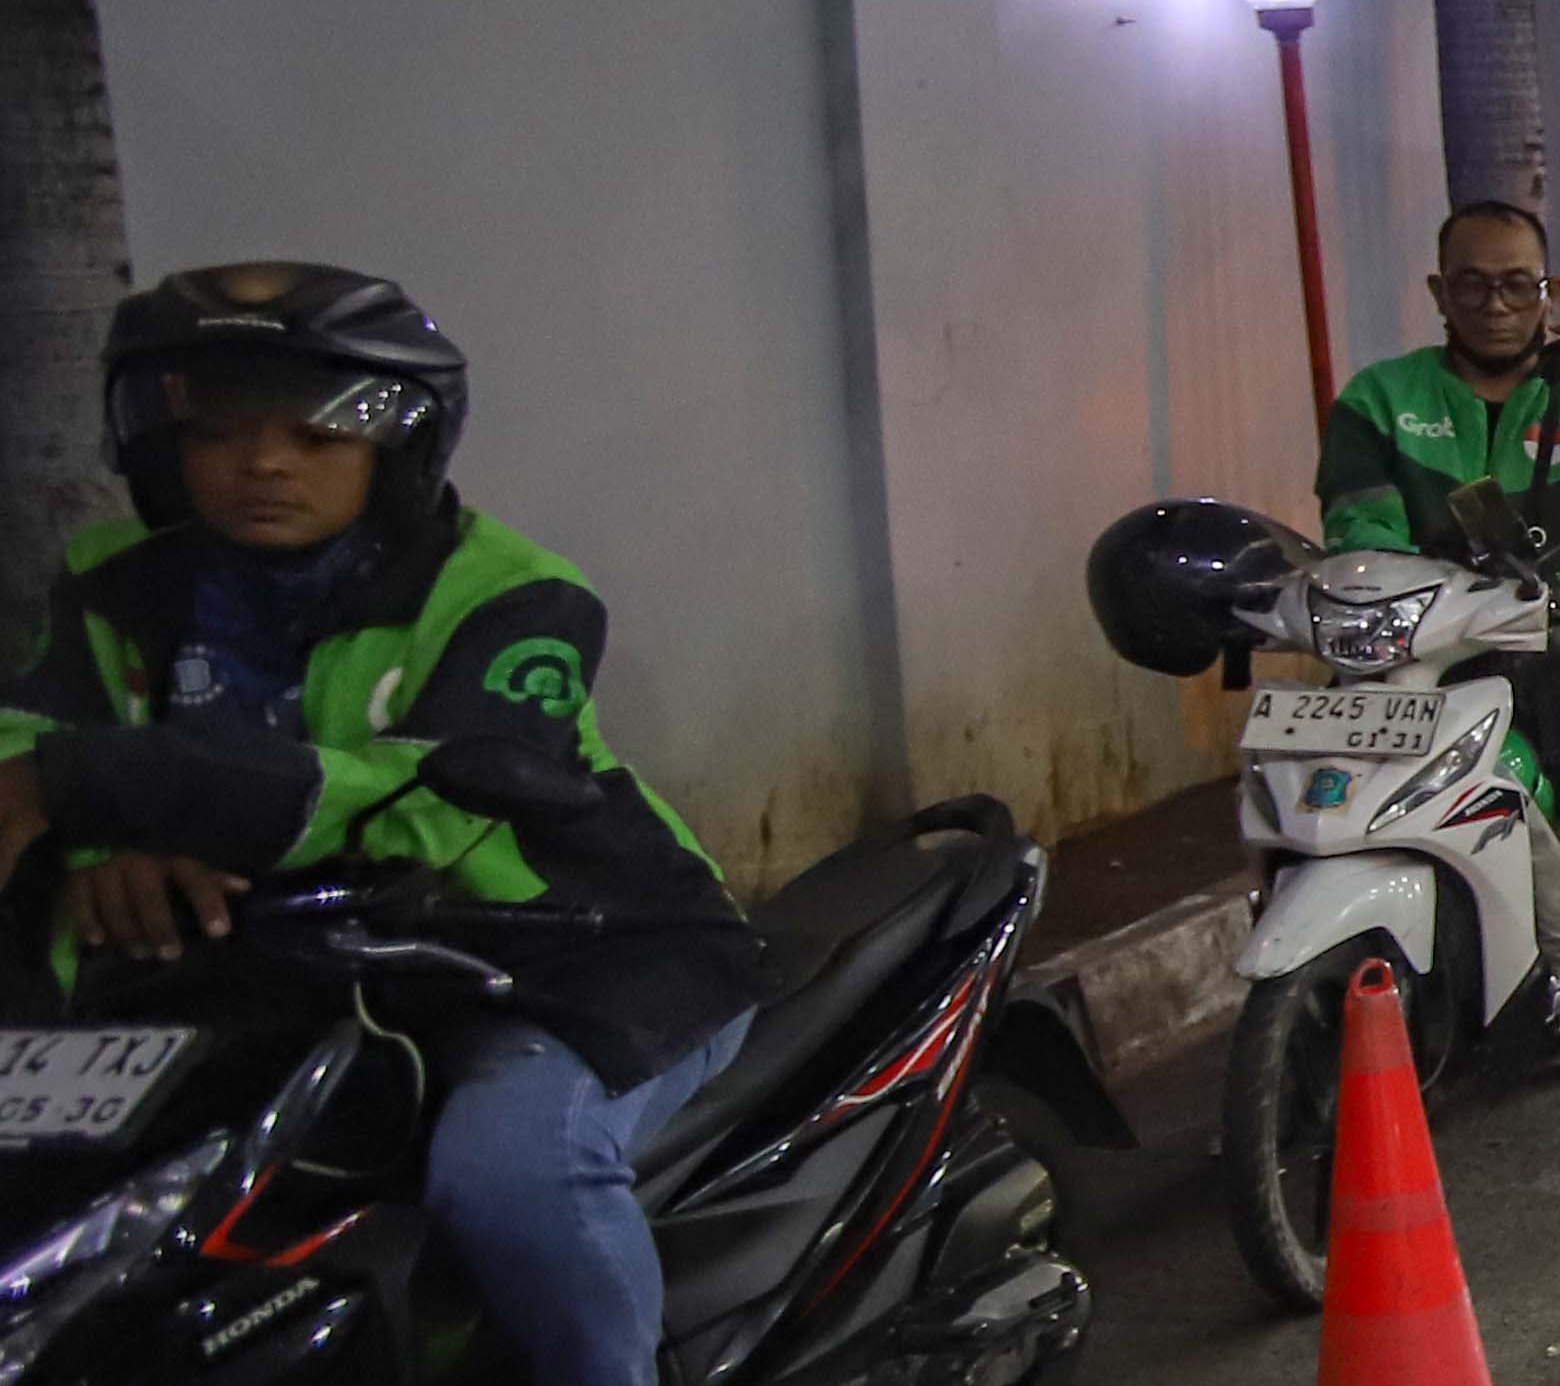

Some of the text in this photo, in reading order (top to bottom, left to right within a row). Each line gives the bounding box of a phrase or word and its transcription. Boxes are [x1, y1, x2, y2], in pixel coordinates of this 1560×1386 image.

[1253, 693, 1273, 718] A
[1291, 695, 1367, 720] 2245
[78, 1035, 177, 1077] TXJ
[202, 1276, 321, 1358] HONDA
